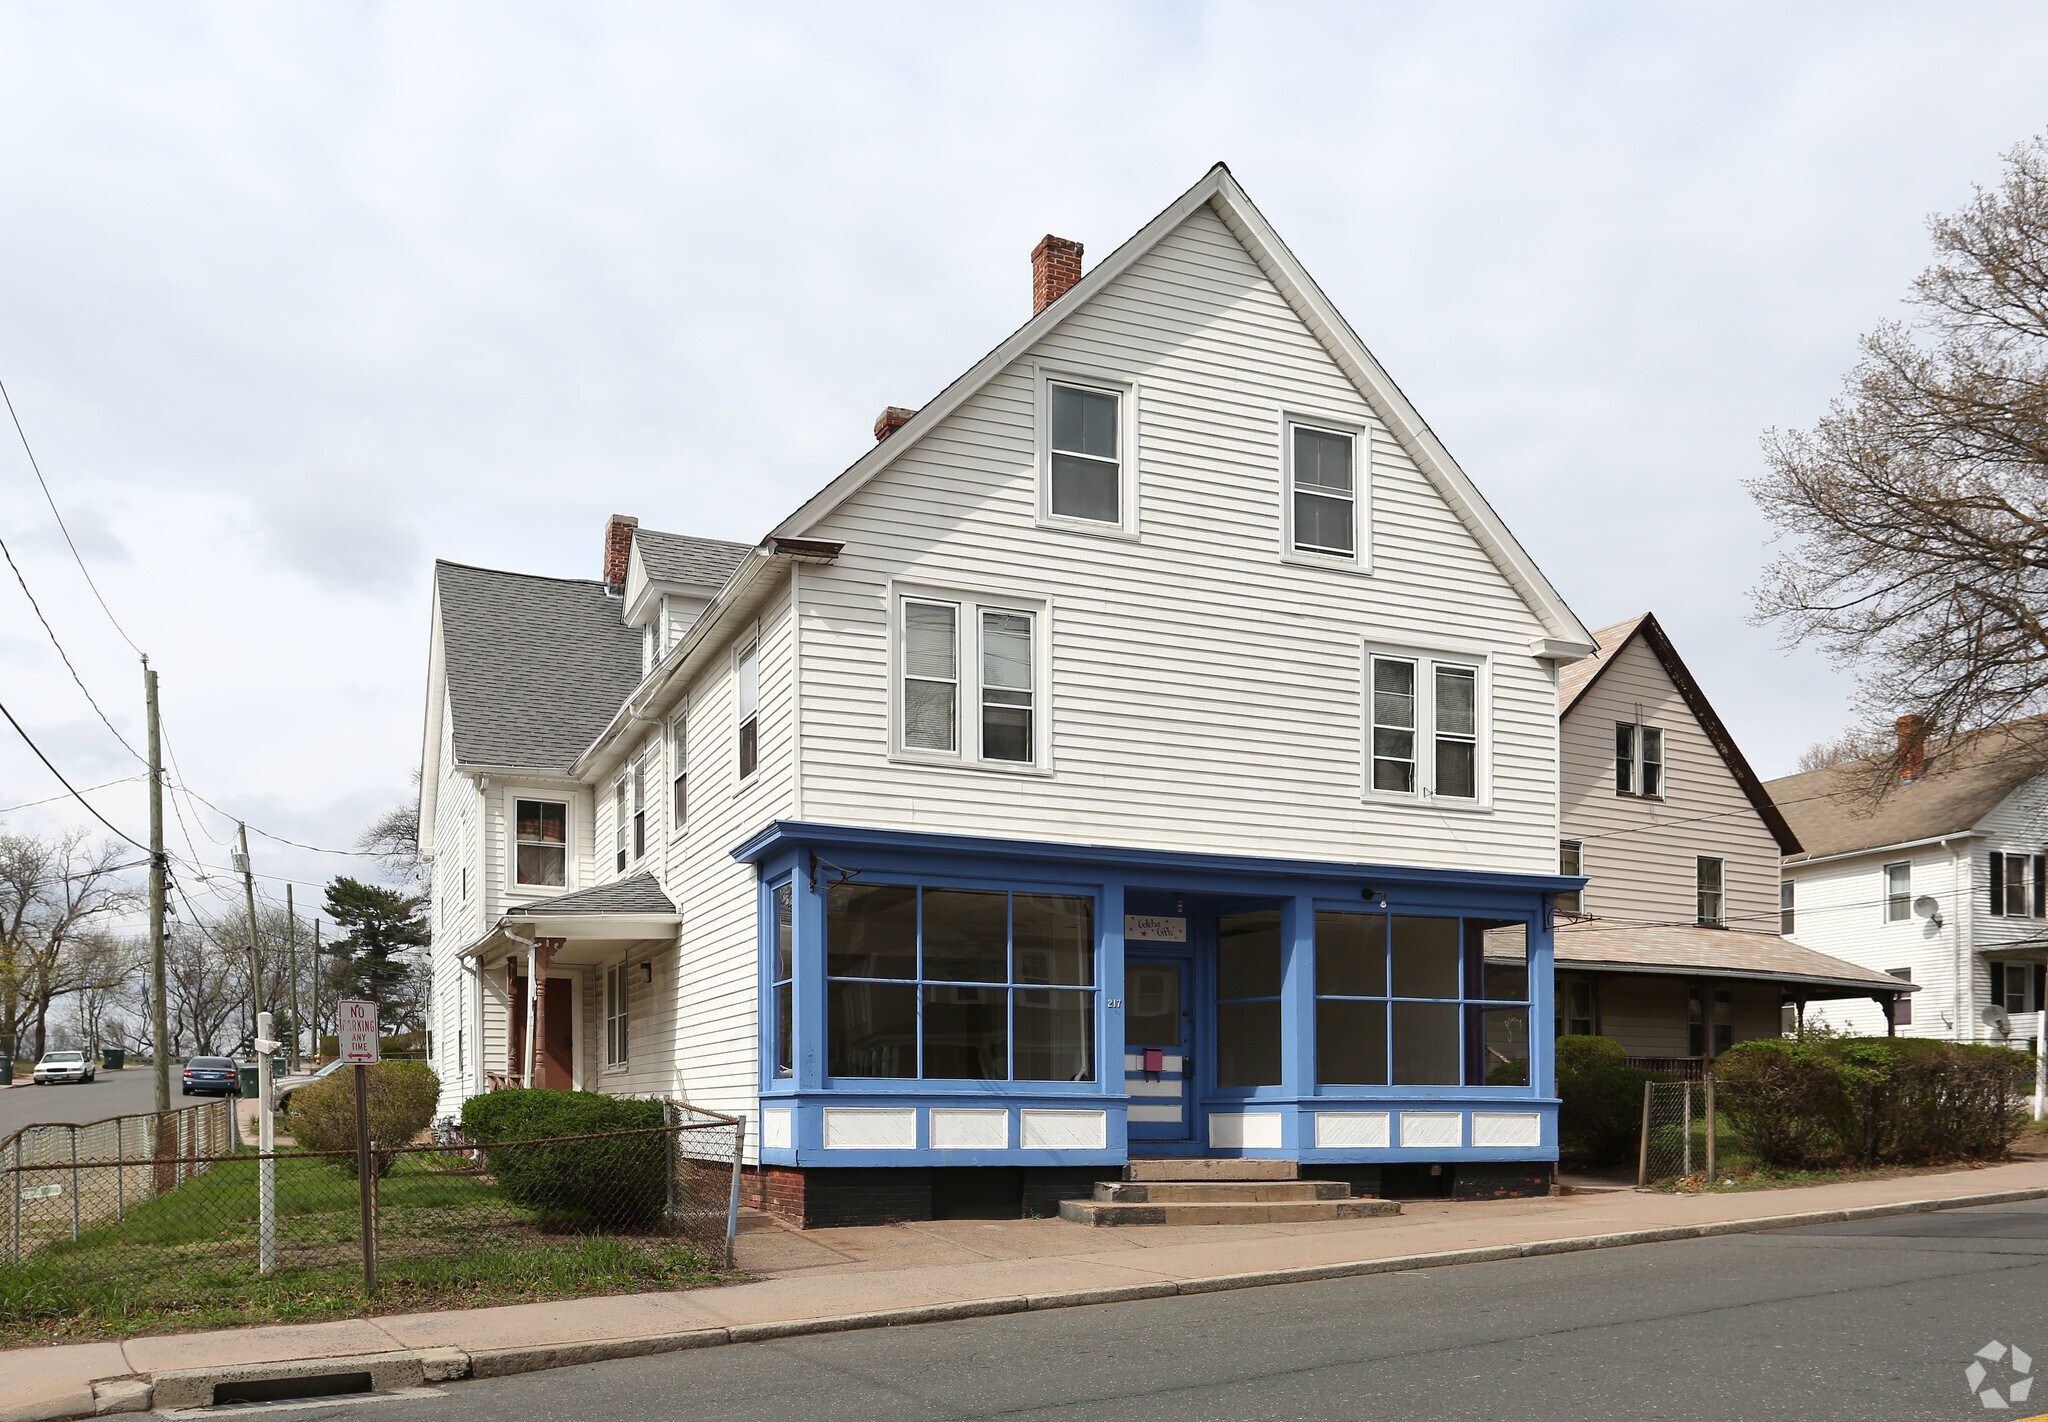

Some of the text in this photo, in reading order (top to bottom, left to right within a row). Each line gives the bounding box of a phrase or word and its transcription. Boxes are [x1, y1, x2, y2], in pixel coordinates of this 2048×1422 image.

[1156, 927, 1174, 937] Gifts
[1107, 998, 1122, 1008] 217
[350, 1006, 365, 1018] NO
[352, 1033, 366, 1041] ANY
[352, 1043, 368, 1051] TIME
